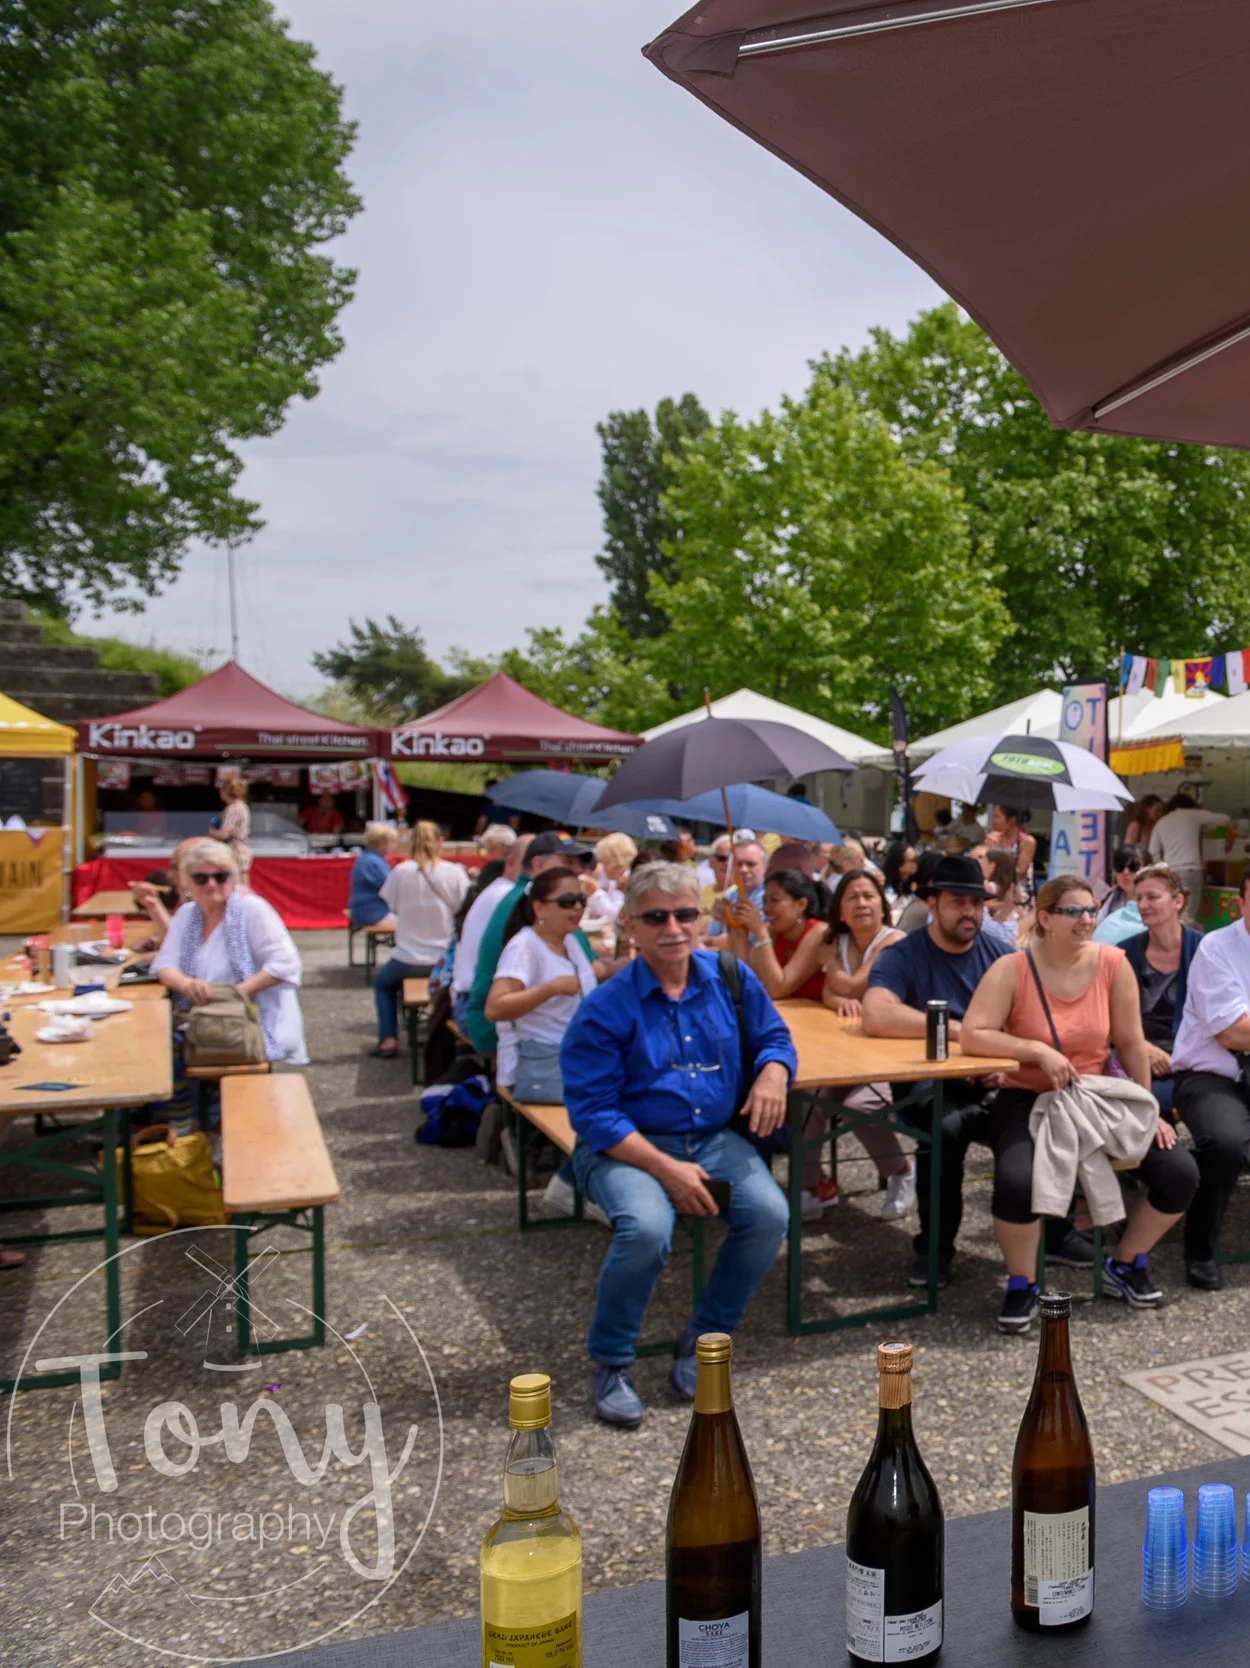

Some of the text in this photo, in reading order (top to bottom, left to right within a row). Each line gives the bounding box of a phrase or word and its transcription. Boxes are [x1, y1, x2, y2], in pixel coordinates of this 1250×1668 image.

[88, 723, 196, 750] Kinkao
[390, 731, 485, 756] Kinkao
[509, 1630, 553, 1642] JAPANESE
[698, 1622, 730, 1632] CHOYA
